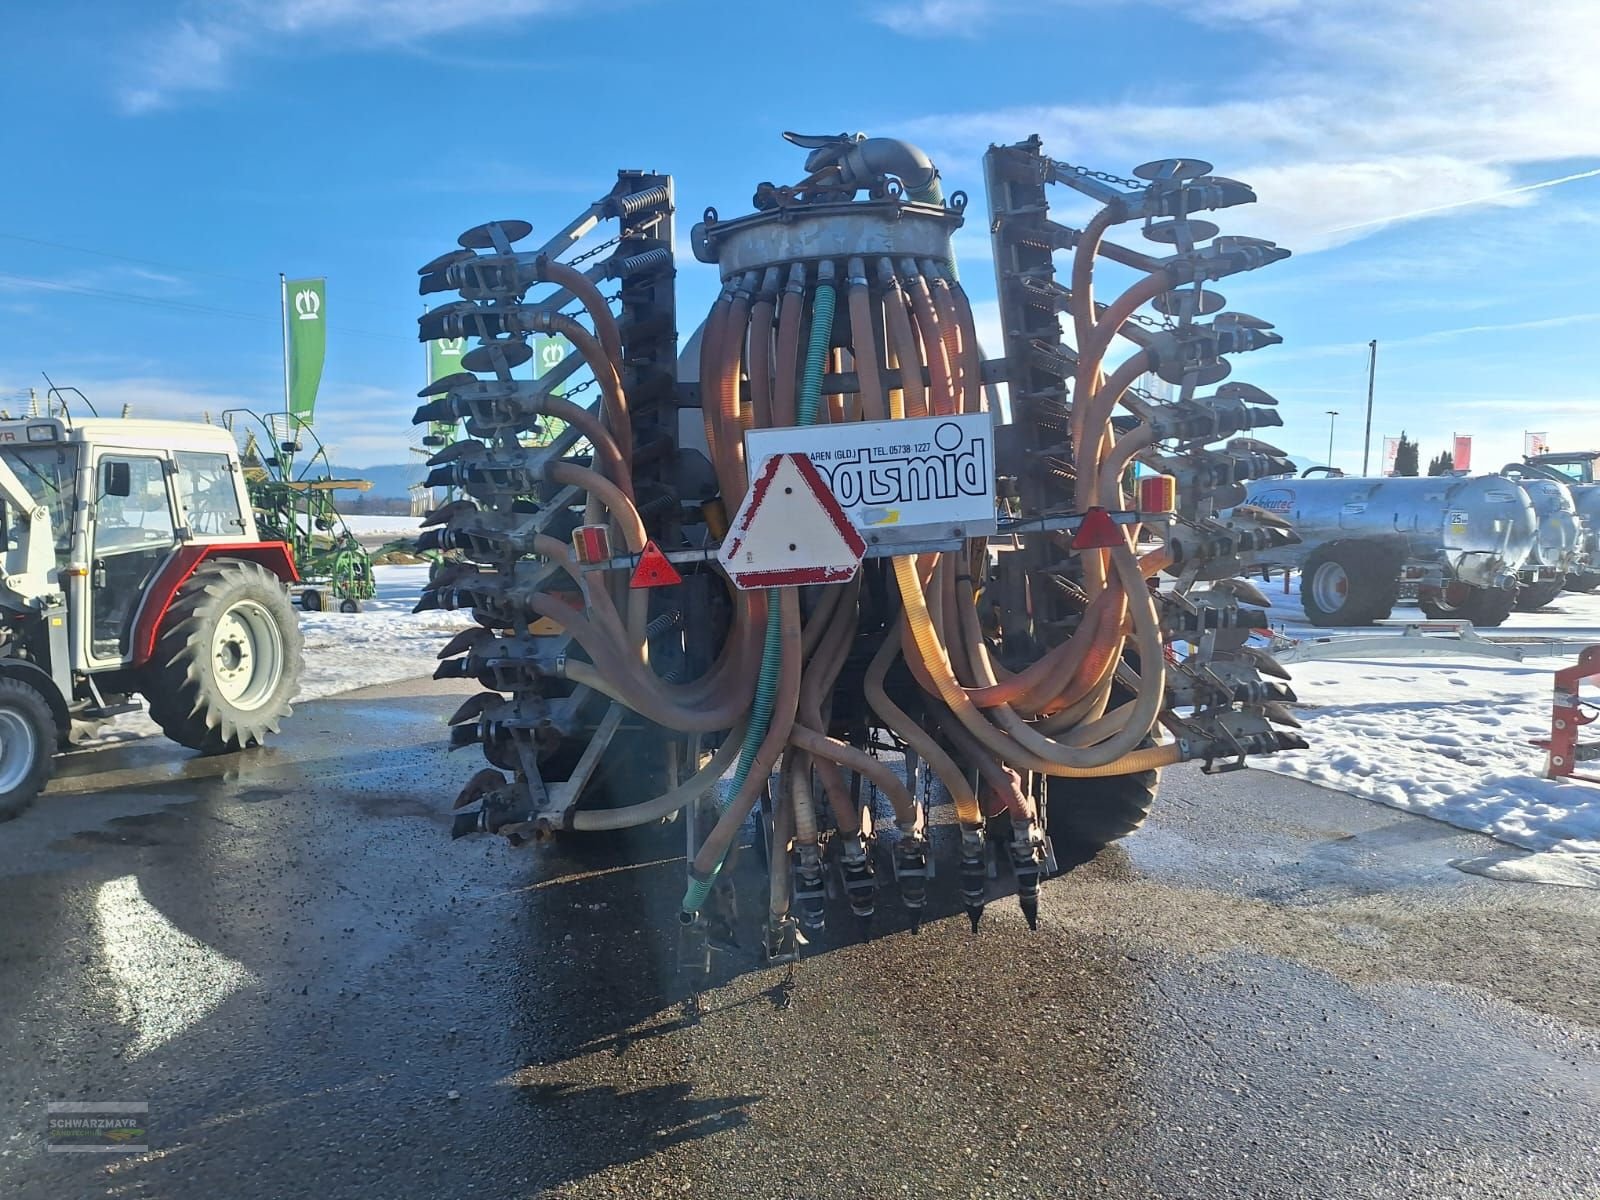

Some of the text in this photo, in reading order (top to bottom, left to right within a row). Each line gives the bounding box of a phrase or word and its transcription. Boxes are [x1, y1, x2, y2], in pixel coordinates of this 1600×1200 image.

[810, 451, 831, 461] AREN
[816, 422, 986, 507] otsmid
[1452, 513, 1461, 523] 25
